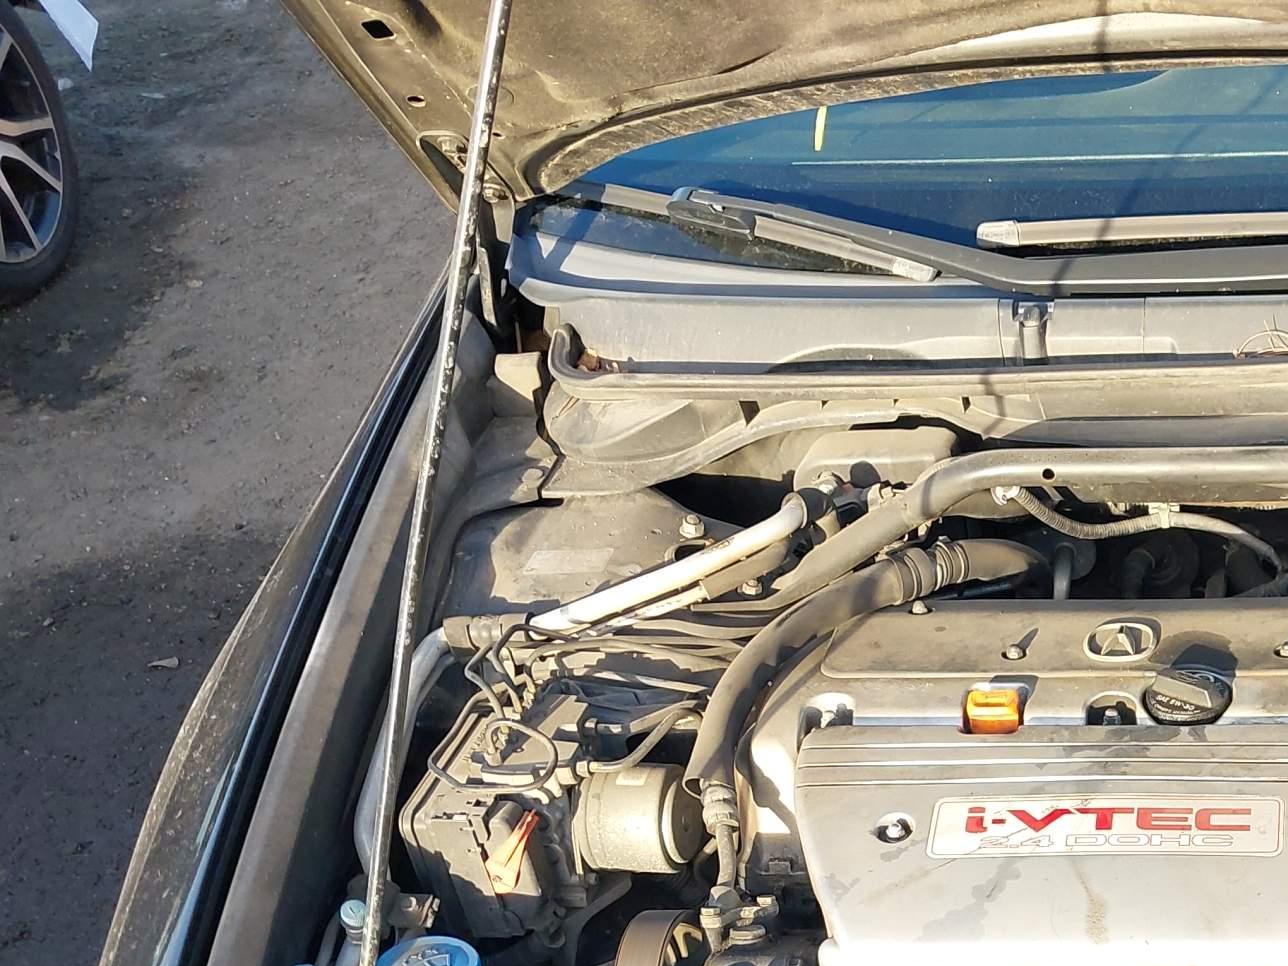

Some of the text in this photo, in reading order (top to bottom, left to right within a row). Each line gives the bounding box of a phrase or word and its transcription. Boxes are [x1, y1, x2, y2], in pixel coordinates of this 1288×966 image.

[964, 806, 1252, 833] i-VTEC
[978, 833, 1236, 849] 2.4 DOHC
